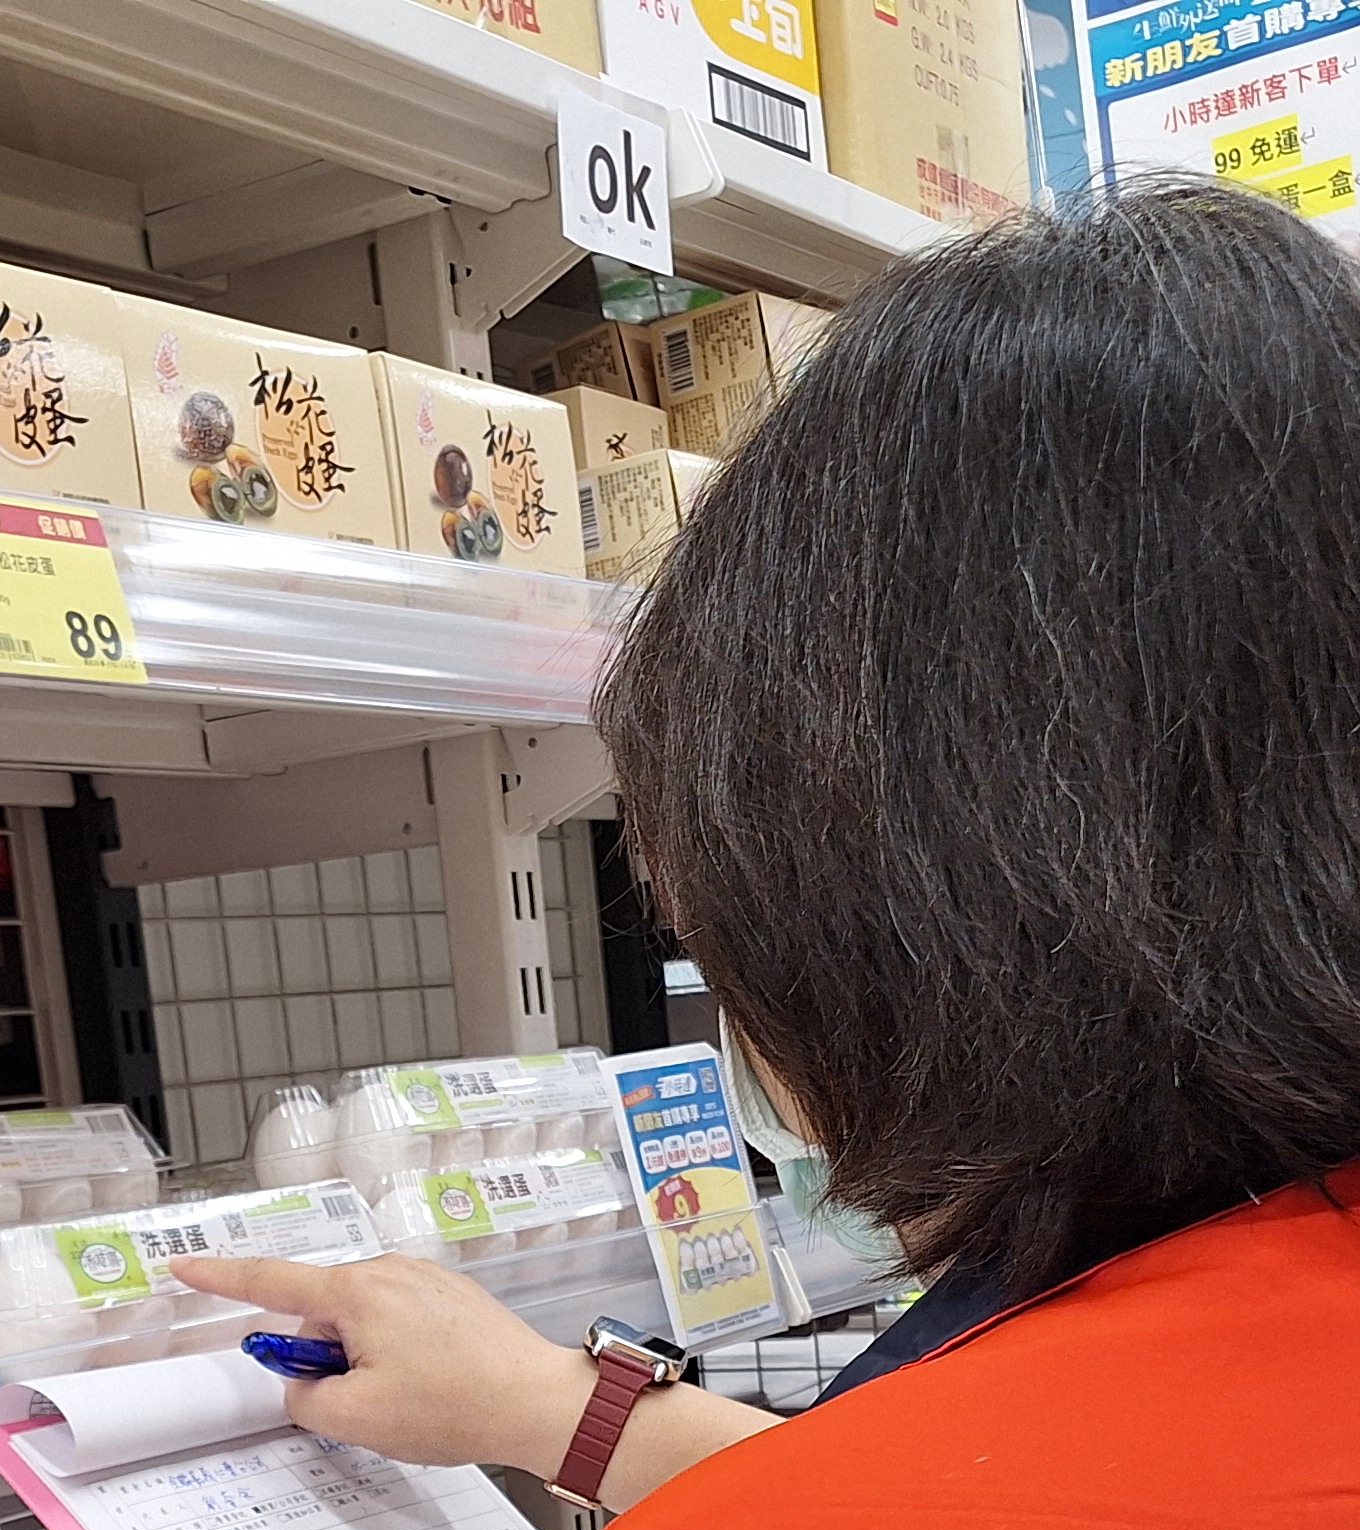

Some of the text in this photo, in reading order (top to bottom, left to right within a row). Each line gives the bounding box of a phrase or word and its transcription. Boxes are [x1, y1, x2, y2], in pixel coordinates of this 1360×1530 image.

[1163, 56, 1342, 134] 小時達新客下單
[1214, 125, 1301, 174] 99 免運
[589, 129, 657, 232] ok
[65, 610, 123, 662] 89
[141, 1223, 210, 1260] 洗選蛋
